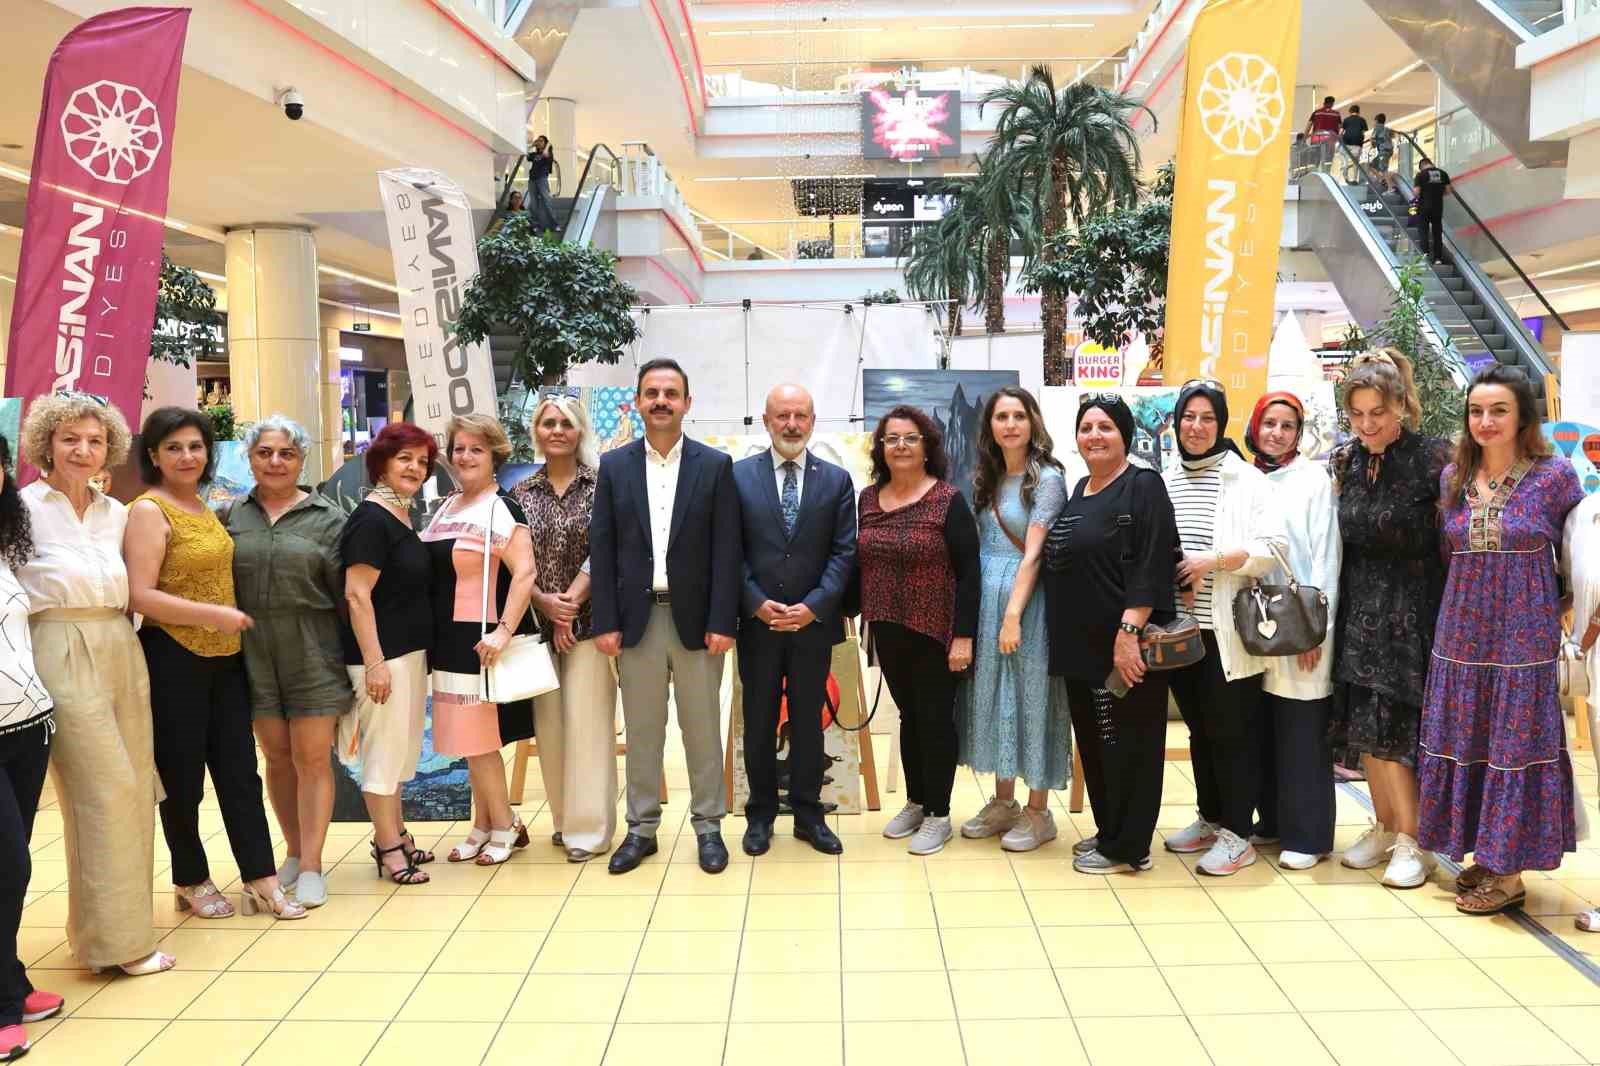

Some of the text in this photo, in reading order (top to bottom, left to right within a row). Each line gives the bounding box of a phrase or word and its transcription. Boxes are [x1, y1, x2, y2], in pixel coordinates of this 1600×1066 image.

[873, 201, 904, 214] dyson
[1199, 179, 1238, 383] ASİNAN
[52, 201, 104, 397] ASİNAN
[1078, 355, 1120, 365] BURGER
[1078, 366, 1120, 378] KING
